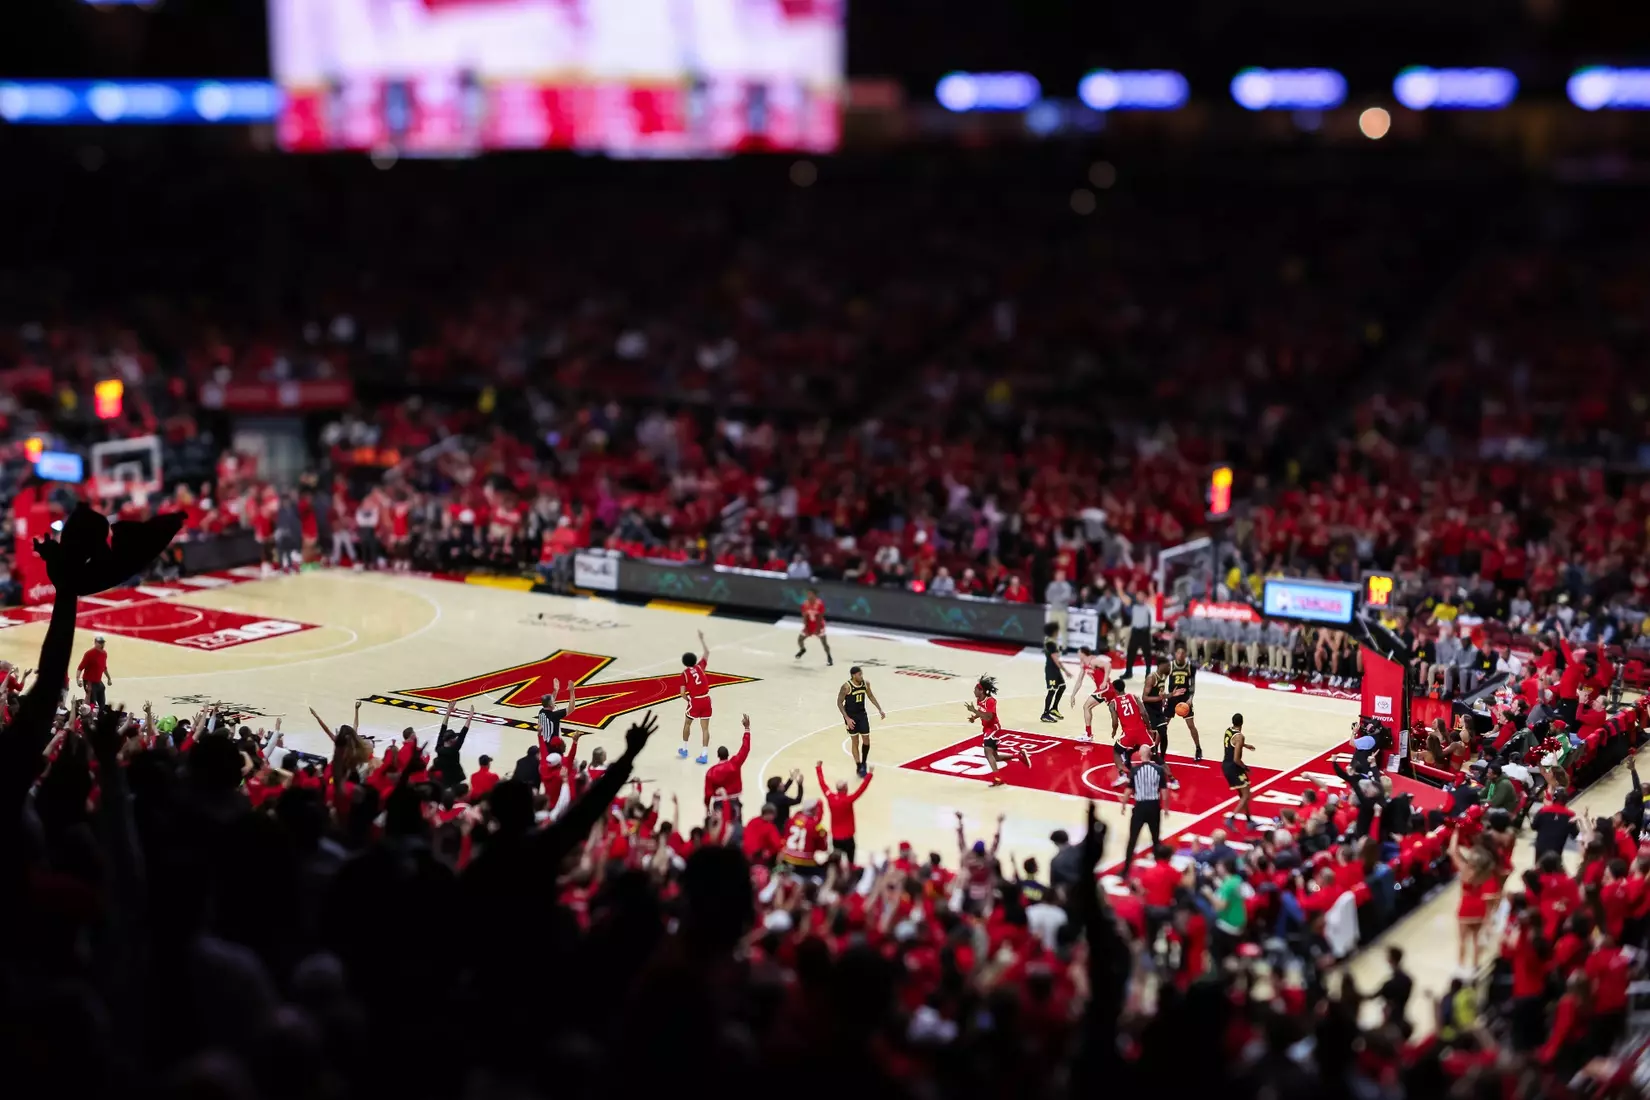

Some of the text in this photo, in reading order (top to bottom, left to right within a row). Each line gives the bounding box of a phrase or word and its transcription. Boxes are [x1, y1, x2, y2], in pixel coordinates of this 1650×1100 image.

[692, 672, 702, 685] 2
[1174, 675, 1186, 685] 23
[855, 694, 862, 703] 11
[1121, 702, 1135, 717] 21
[1371, 714, 1394, 722] TOYOTA
[786, 825, 807, 852] 21
